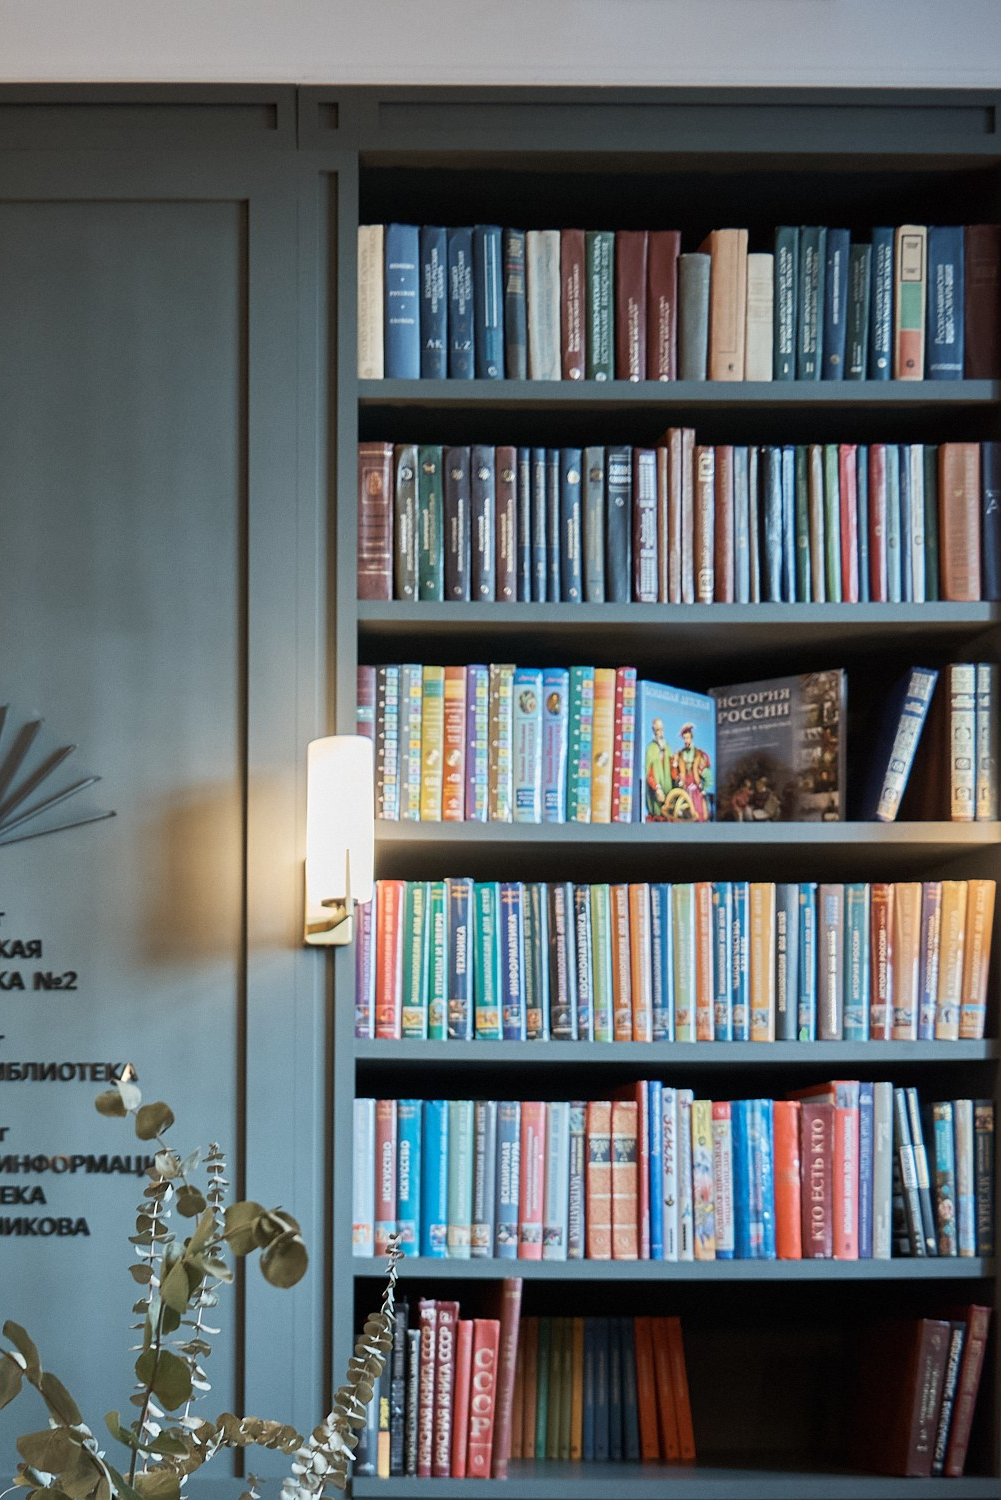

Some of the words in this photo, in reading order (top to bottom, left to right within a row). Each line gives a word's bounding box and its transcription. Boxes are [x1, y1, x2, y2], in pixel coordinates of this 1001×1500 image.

[718, 687, 791, 709] ИСТОРИЯ
[718, 702, 790, 725] РОССИИ
[411, 888, 423, 916] ДЕТЕЙ
[555, 887, 565, 916] ДЕТЕЙ
[435, 912, 444, 945] ЗВЕРИ
[456, 925, 467, 975] ТЕХНИКА
[852, 929, 860, 962] РОССИИ
[878, 929, 887, 962] РОССИИ
[411, 937, 422, 1003] ЭНЦИКЛОПЕДИЯ
[435, 957, 444, 996] ПТИЦЫ
[483, 936, 492, 1003] ЭНЦИКЛОПЕДИЯ
[508, 913, 520, 997] ИНФОРМАТИКА
[557, 935, 567, 1003] ЭНЦИКЛОПЕДИЯ
[577, 912, 589, 999] КОСМОНАВТИКА
[33, 970, 78, 991] №2
[852, 963, 860, 1000] ИСТОРИЯ
[878, 963, 887, 1000] ИСТОРИЯ
[811, 1118, 824, 1154] КТО
[382, 1141, 392, 1203] ИСКУССТВО
[400, 1139, 411, 1202] ИСКУССТВО
[475, 1154, 484, 1220] ЭНЦИКЛОПЕДИЯ
[500, 1142, 510, 1205] ВСЕМИРНАЯ
[510, 1141, 520, 1205] ЛИТЕРАТУРА
[811, 1158, 824, 1202] ЕСТЬ
[569, 1174, 582, 1242] МАТЕМАТИКА
[811, 1206, 825, 1241] КТО
[978, 1175, 991, 1234] МУЗЫКА
[421, 1325, 435, 1361] СССР
[439, 1325, 452, 1361] СССР
[420, 1361, 434, 1406] КНИГА
[437, 1362, 451, 1407] КНИГА
[470, 1347, 494, 1437] СССР
[420, 1407, 433, 1467] КРАСНАЯ
[436, 1407, 450, 1468] КРАСНАЯ
